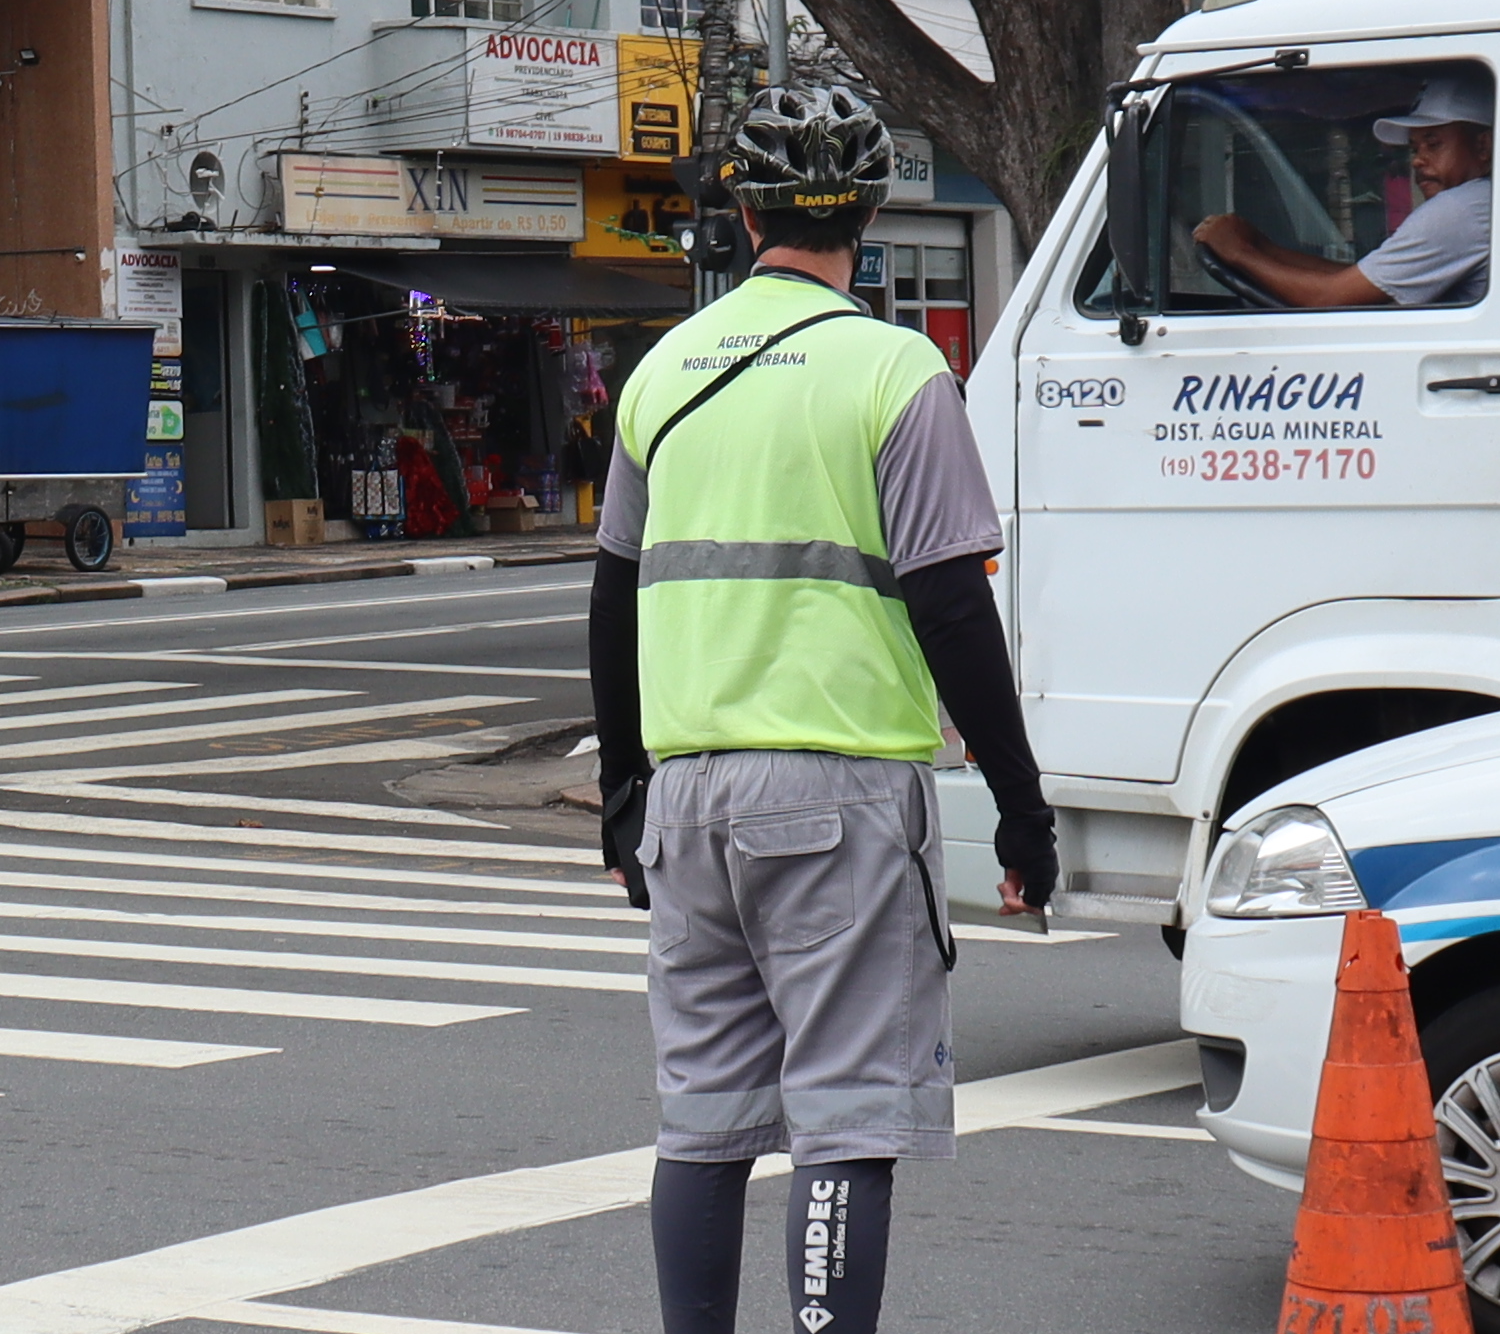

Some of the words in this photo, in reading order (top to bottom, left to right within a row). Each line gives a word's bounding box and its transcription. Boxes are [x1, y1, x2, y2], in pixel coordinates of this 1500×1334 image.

[486, 34, 600, 67] ADVOCACIA
[406, 168, 469, 214] XIN
[794, 190, 858, 207] EMDEC
[498, 218, 512, 230] de
[537, 214, 566, 232] 0,50
[121, 253, 178, 268] ADVOCACIA
[717, 335, 764, 349] AGENTE
[756, 352, 807, 367] URBANA
[1039, 378, 1126, 409] 8-120
[1173, 366, 1365, 415] RINÁGUA
[1155, 423, 1204, 443] DIST.
[1212, 416, 1276, 442] ÁGUA
[1284, 420, 1383, 440] MINERAL
[1161, 455, 1196, 478] (19)
[1200, 447, 1377, 481] 3238-7170
[837, 1180, 850, 1205] Vida
[837, 1204, 848, 1221] da
[805, 1180, 834, 1296] EMDEC
[833, 1223, 846, 1260] Defesa
